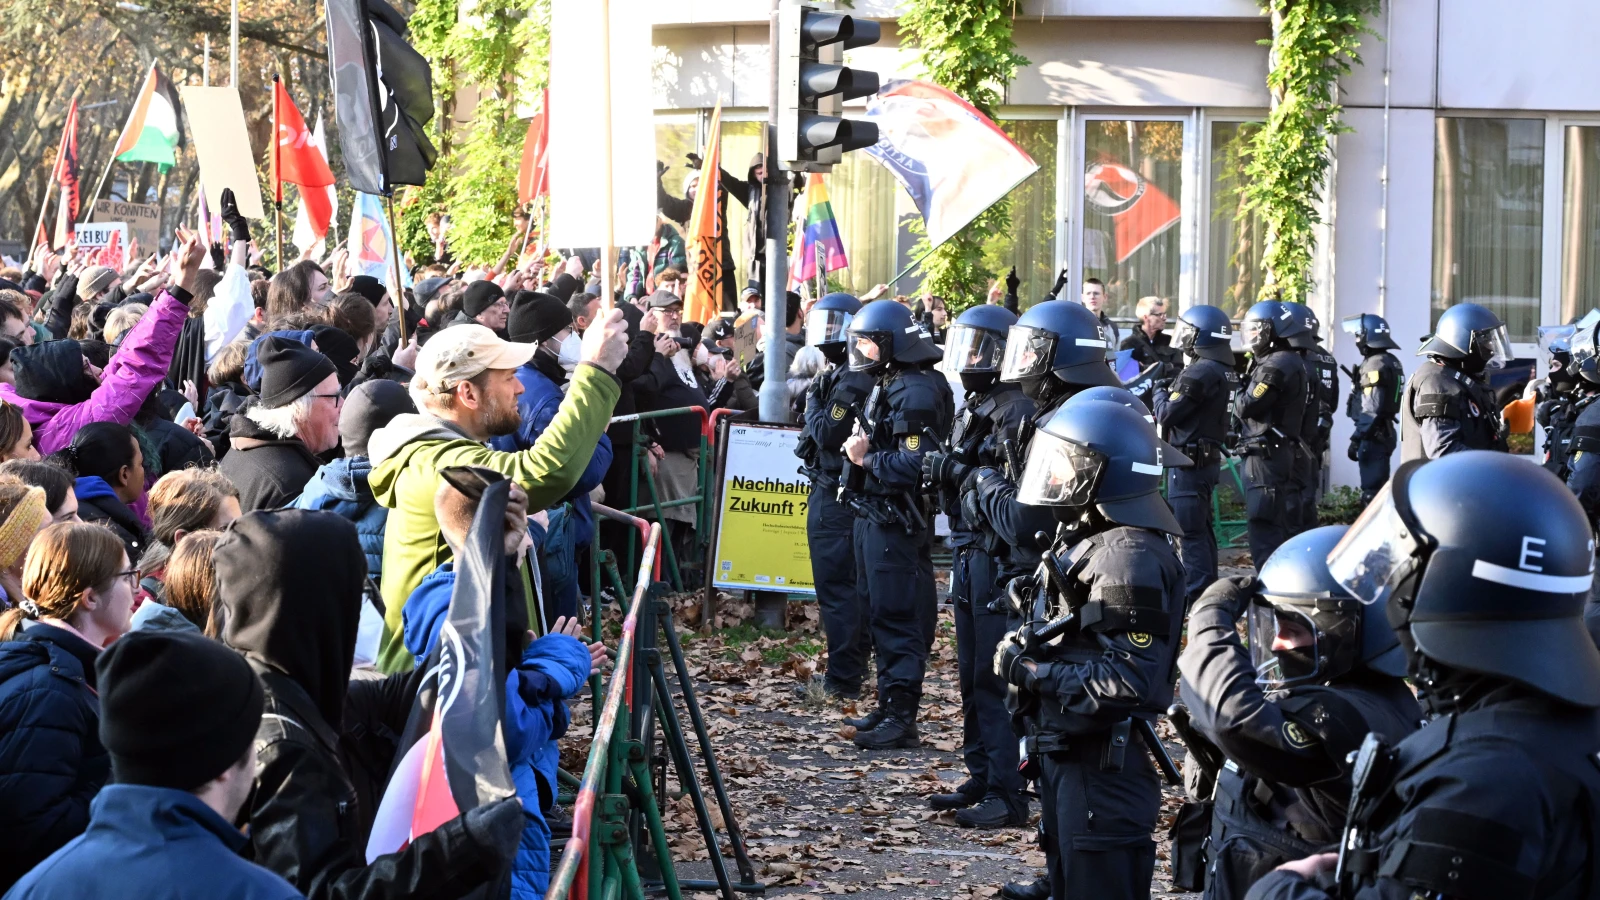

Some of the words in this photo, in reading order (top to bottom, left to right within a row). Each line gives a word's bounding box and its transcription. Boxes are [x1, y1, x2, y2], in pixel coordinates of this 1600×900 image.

[729, 496, 794, 515] Zukunft
[799, 502, 808, 516] ?
[1519, 536, 1546, 571] E
